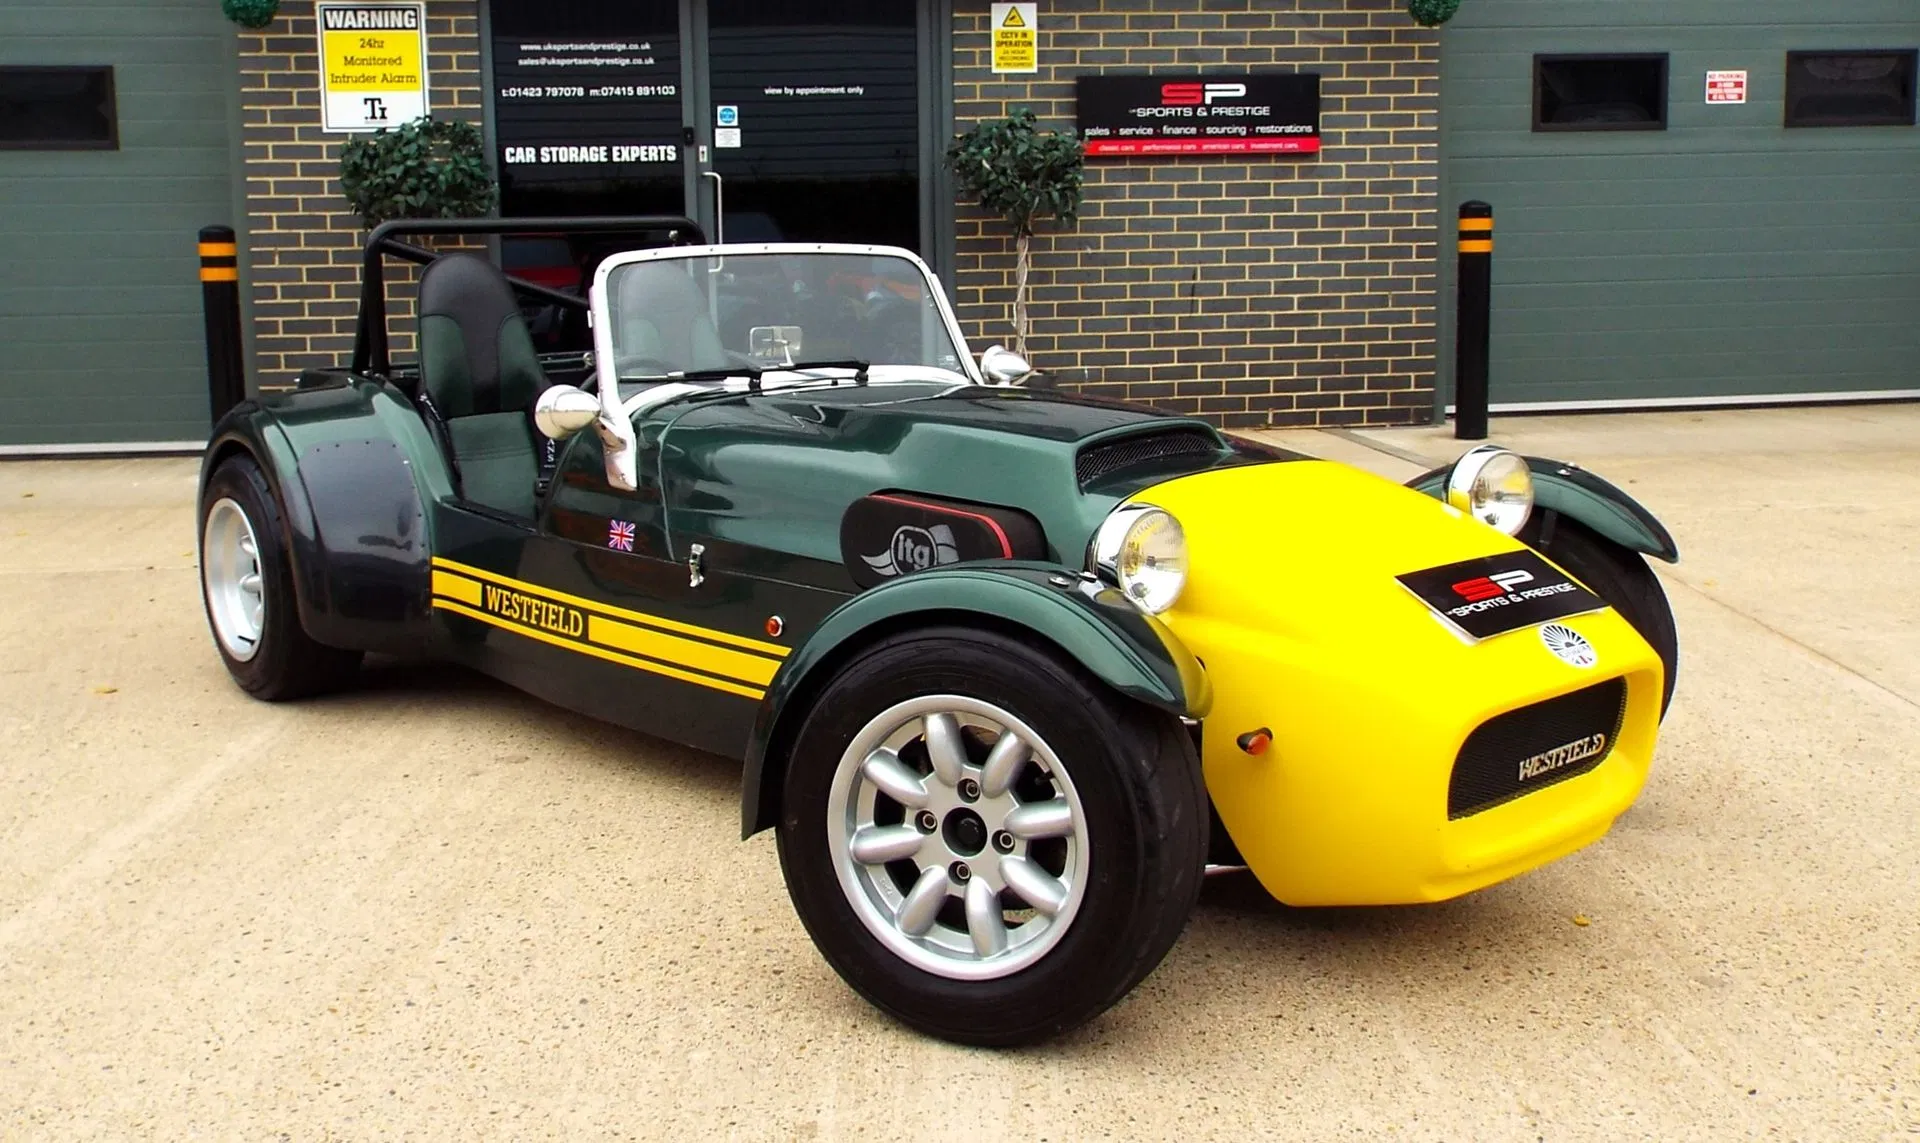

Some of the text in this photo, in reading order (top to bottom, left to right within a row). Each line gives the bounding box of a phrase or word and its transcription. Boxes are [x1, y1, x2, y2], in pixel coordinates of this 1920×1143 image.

[325, 10, 416, 28] WARNING
[360, 38, 384, 48] 24hr
[520, 42, 651, 52] www.uksportsandprestige.co.uk
[344, 56, 402, 66] Monitored
[518, 57, 654, 67] sales@uksportsandprestige.co.uk
[331, 73, 417, 84] Intruder Alarm
[502, 87, 542, 97] t:01423
[545, 87, 584, 97] 797078
[589, 86, 634, 96] m:07415
[764, 86, 864, 96] view by appointment only
[1162, 83, 1246, 105] SP
[1136, 107, 1193, 117] SPORTS
[1197, 107, 1208, 116] &
[1211, 106, 1270, 116] PRESTIGE
[1085, 124, 1313, 136] sales service finance sourcing restorations
[505, 146, 677, 163] CAR STORAGE EXPERTS
[1452, 570, 1535, 602] SP
[1452, 582, 1577, 617] SPORTS & PRESTIGE
[485, 585, 584, 638] WESTFIELD
[1518, 733, 1605, 781] WESTFIELD
